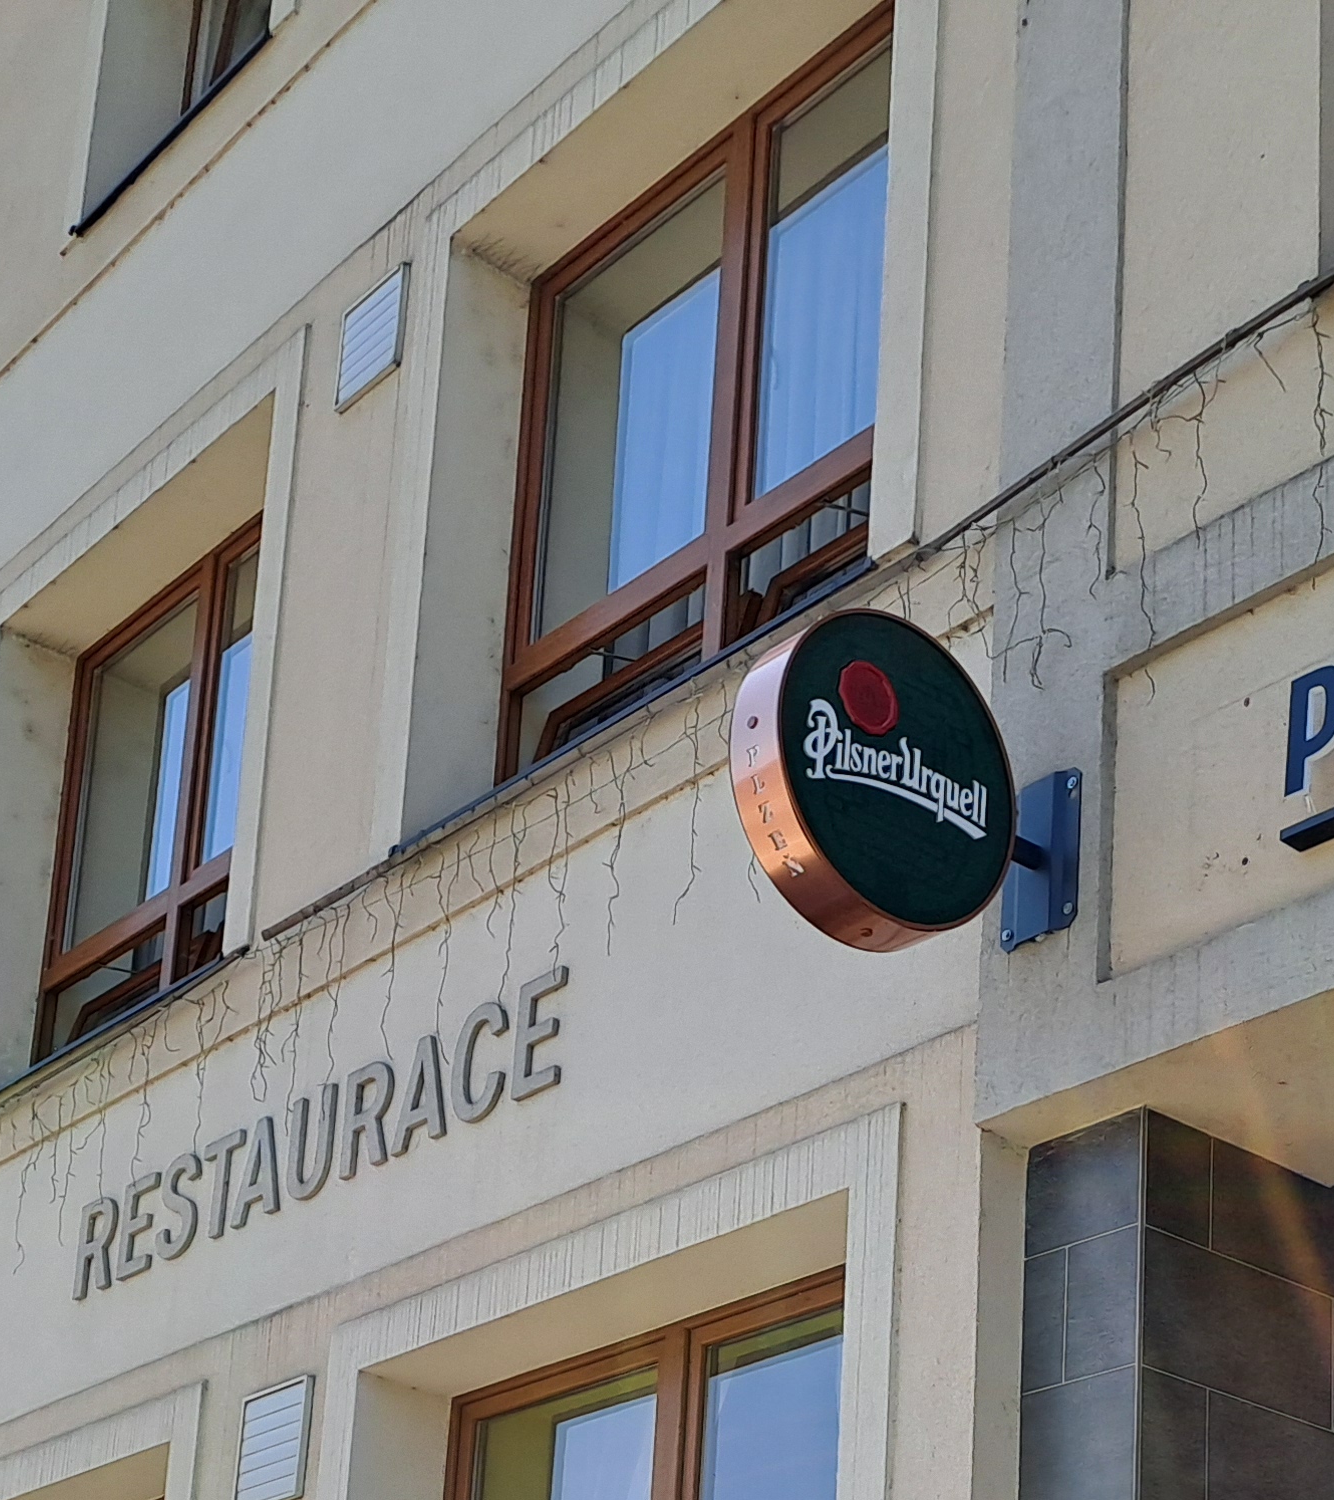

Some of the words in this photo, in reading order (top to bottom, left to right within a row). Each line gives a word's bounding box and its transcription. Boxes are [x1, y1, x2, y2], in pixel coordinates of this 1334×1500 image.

[746, 745, 806, 878] PLZEŇ
[803, 698, 907, 780] Pilsner
[898, 737, 987, 828] Urquell
[71, 965, 570, 1301] RESTAURACE
